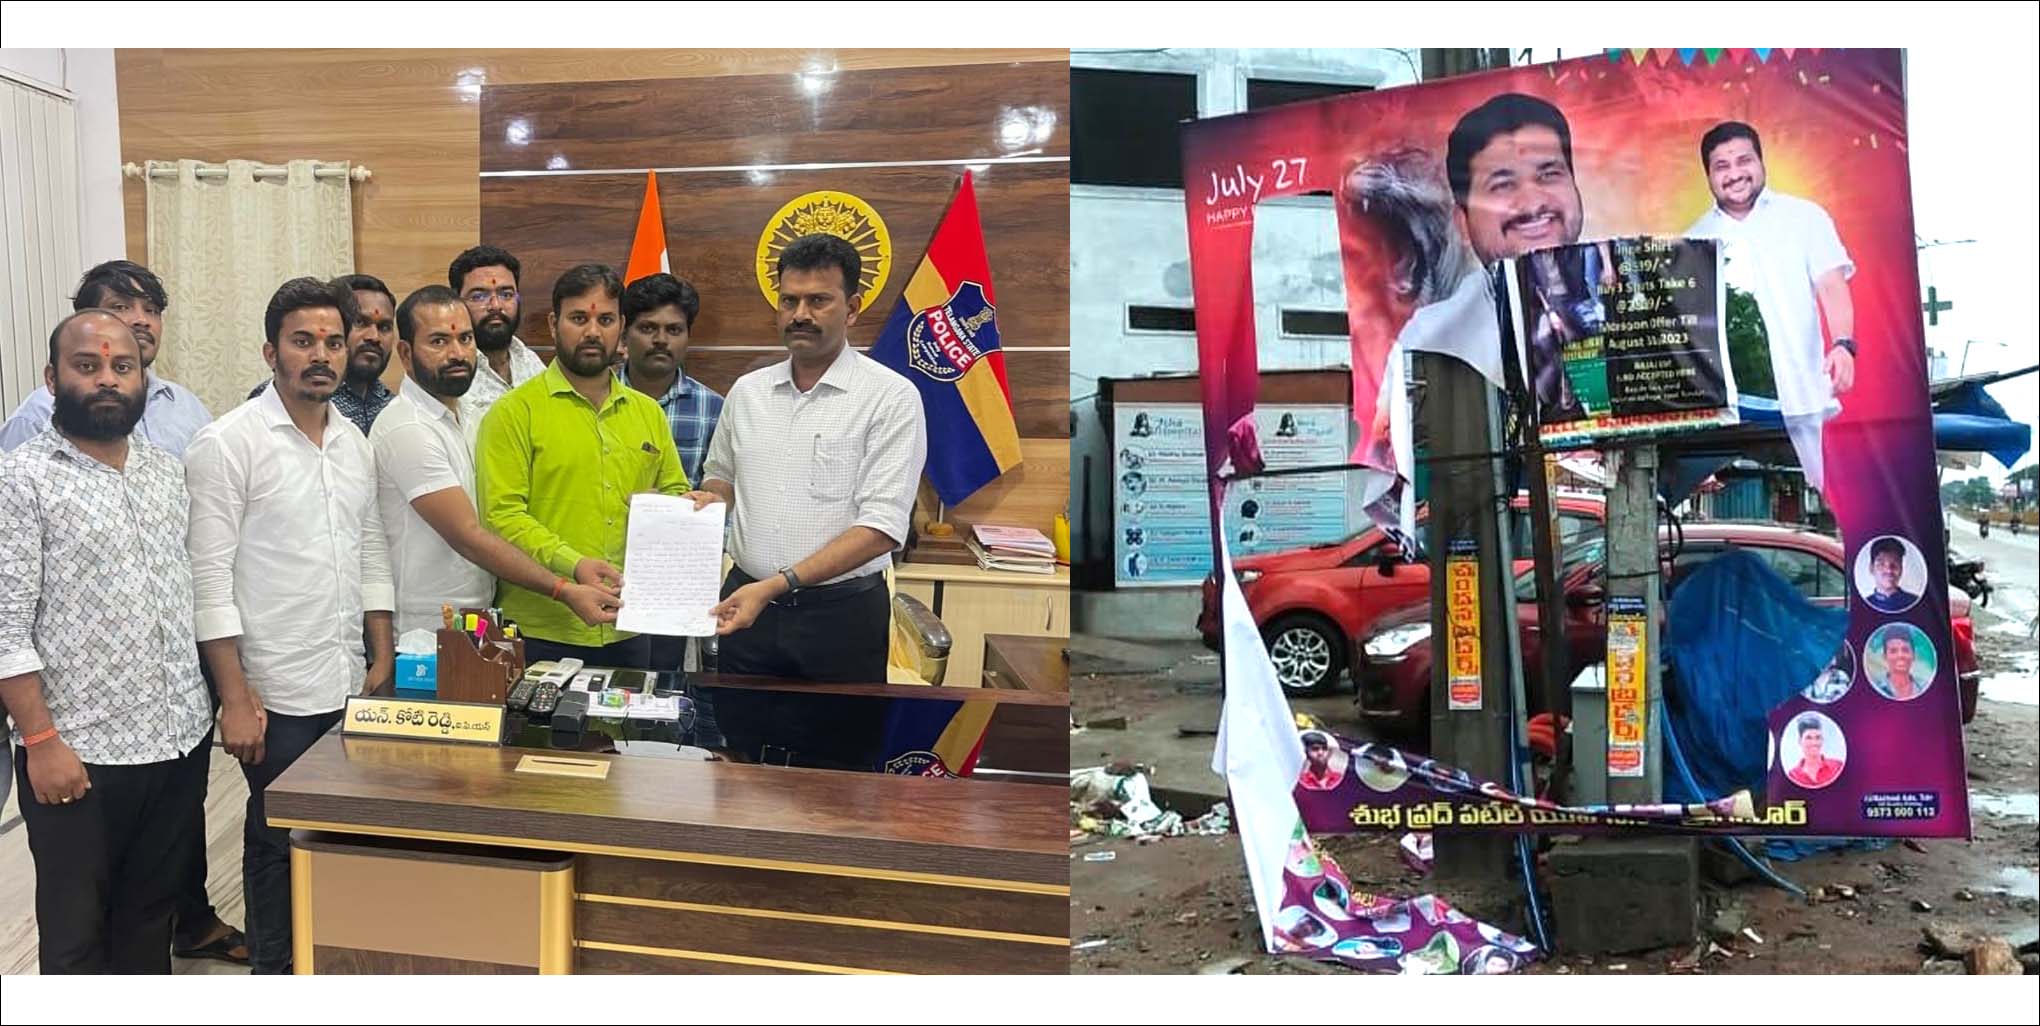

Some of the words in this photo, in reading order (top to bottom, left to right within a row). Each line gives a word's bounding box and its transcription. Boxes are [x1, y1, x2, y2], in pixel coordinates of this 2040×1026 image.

[1206, 164, 1264, 205] July
[1272, 157, 1308, 190] 27
[1206, 205, 1248, 225] HAPPY
[928, 309, 973, 369] POLICE
[1349, 803, 1401, 829] శుభ
